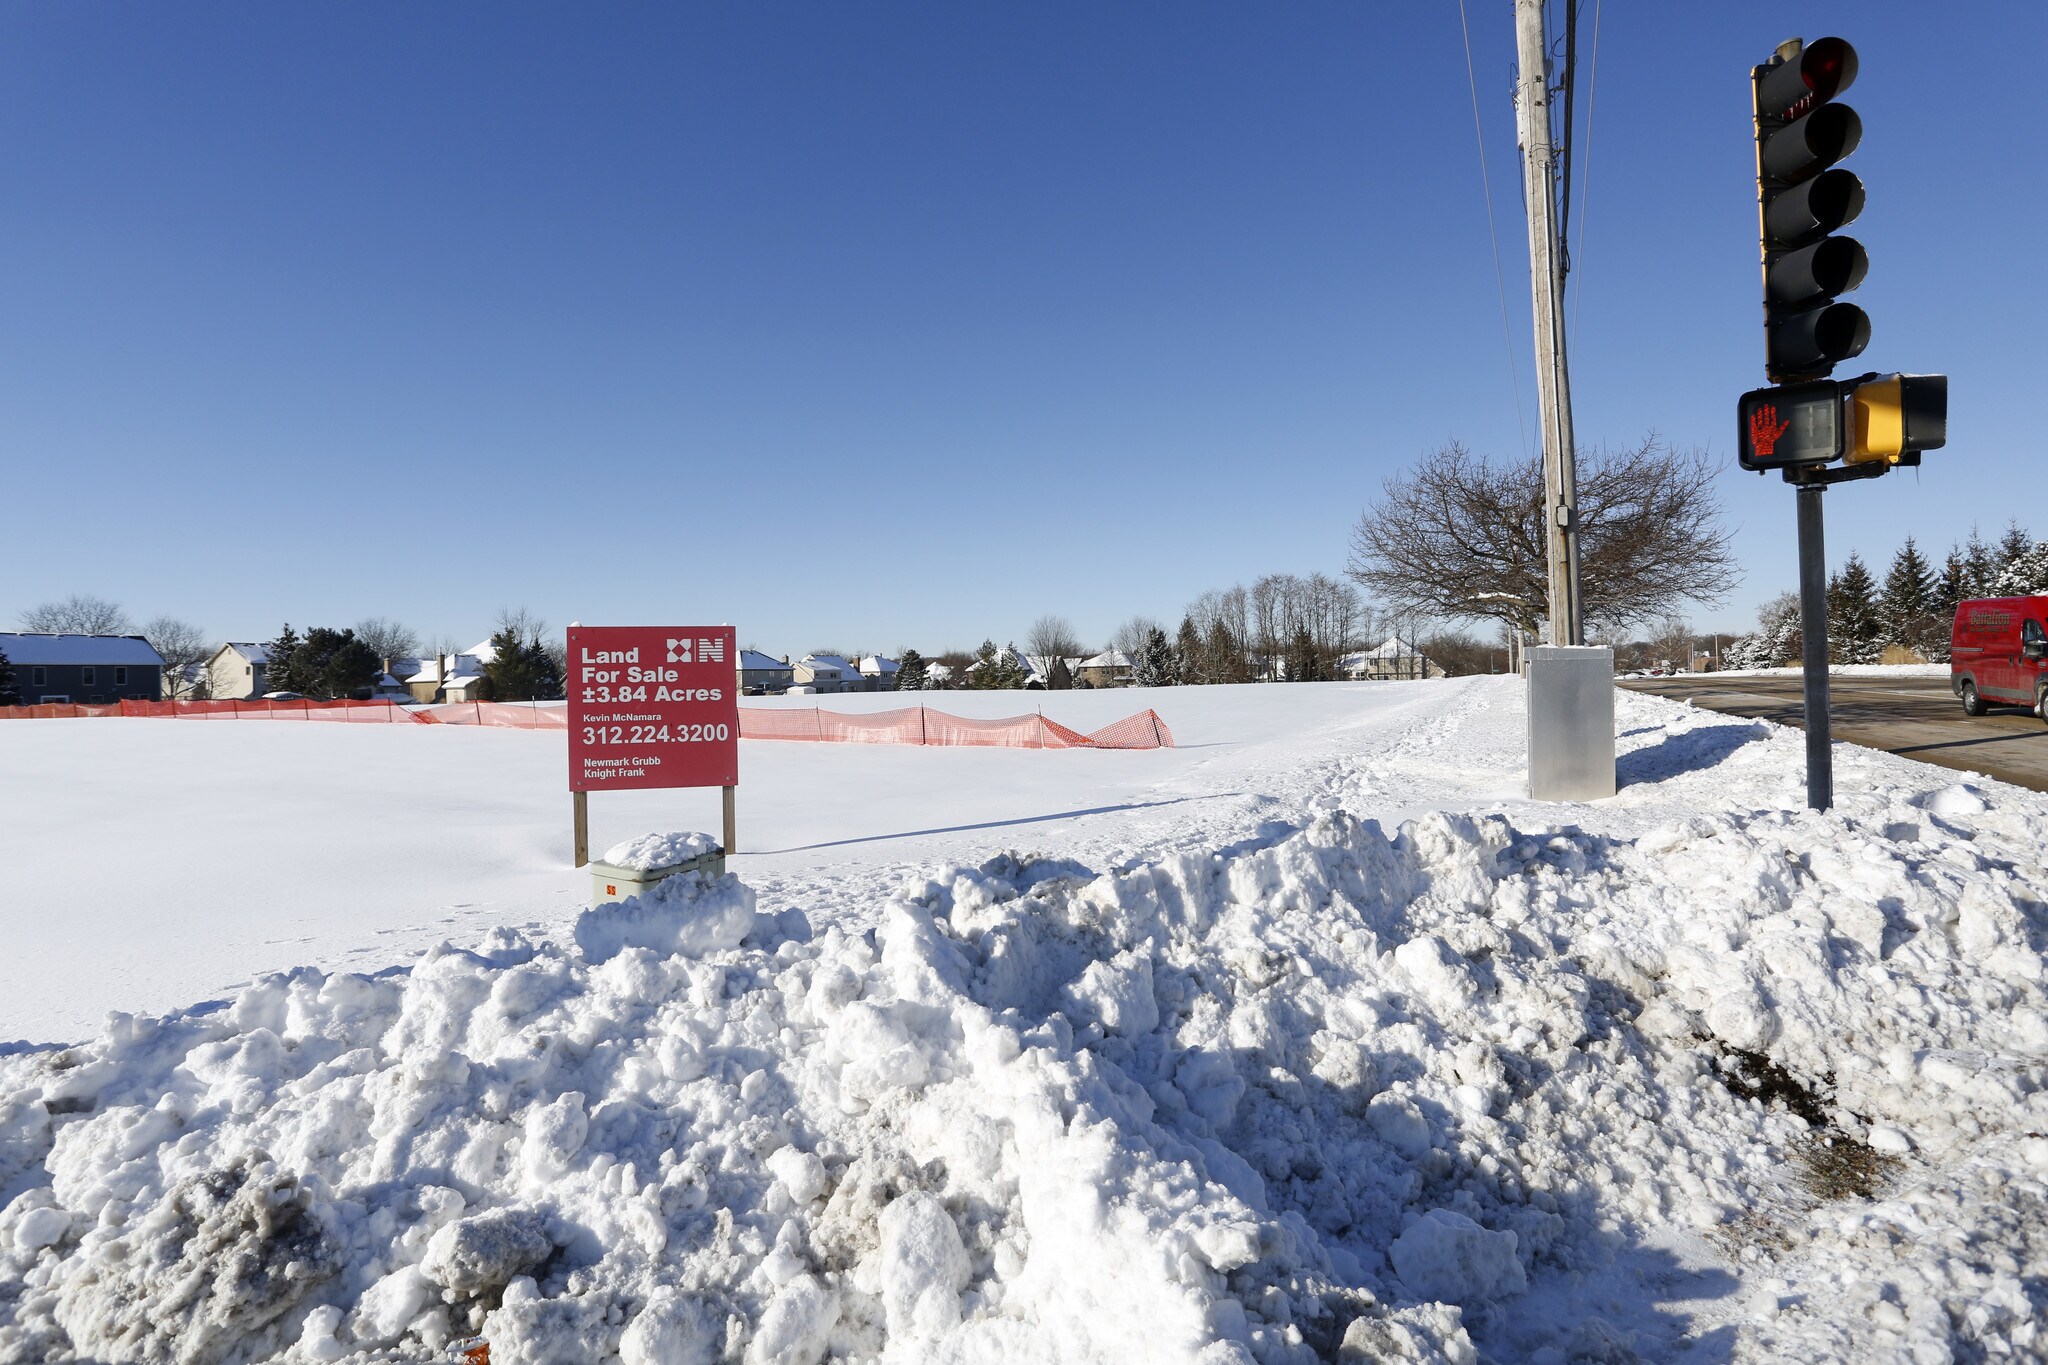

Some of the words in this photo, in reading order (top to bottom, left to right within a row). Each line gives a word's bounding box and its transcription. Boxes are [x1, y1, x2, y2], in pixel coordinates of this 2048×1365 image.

[1971, 609, 2010, 625] Battalion
[581, 647, 639, 664] Land
[581, 667, 620, 684] For
[627, 666, 679, 683] Sale
[582, 686, 647, 703] ±3.84
[654, 685, 722, 702] Acres
[583, 714, 610, 722] Kevin
[612, 713, 662, 722] McNamara
[582, 723, 729, 745] 312.224.3200
[584, 757, 630, 767] Newmark
[632, 756, 661, 766] Grubb
[584, 768, 616, 780] Knight
[618, 767, 645, 777] Frank
